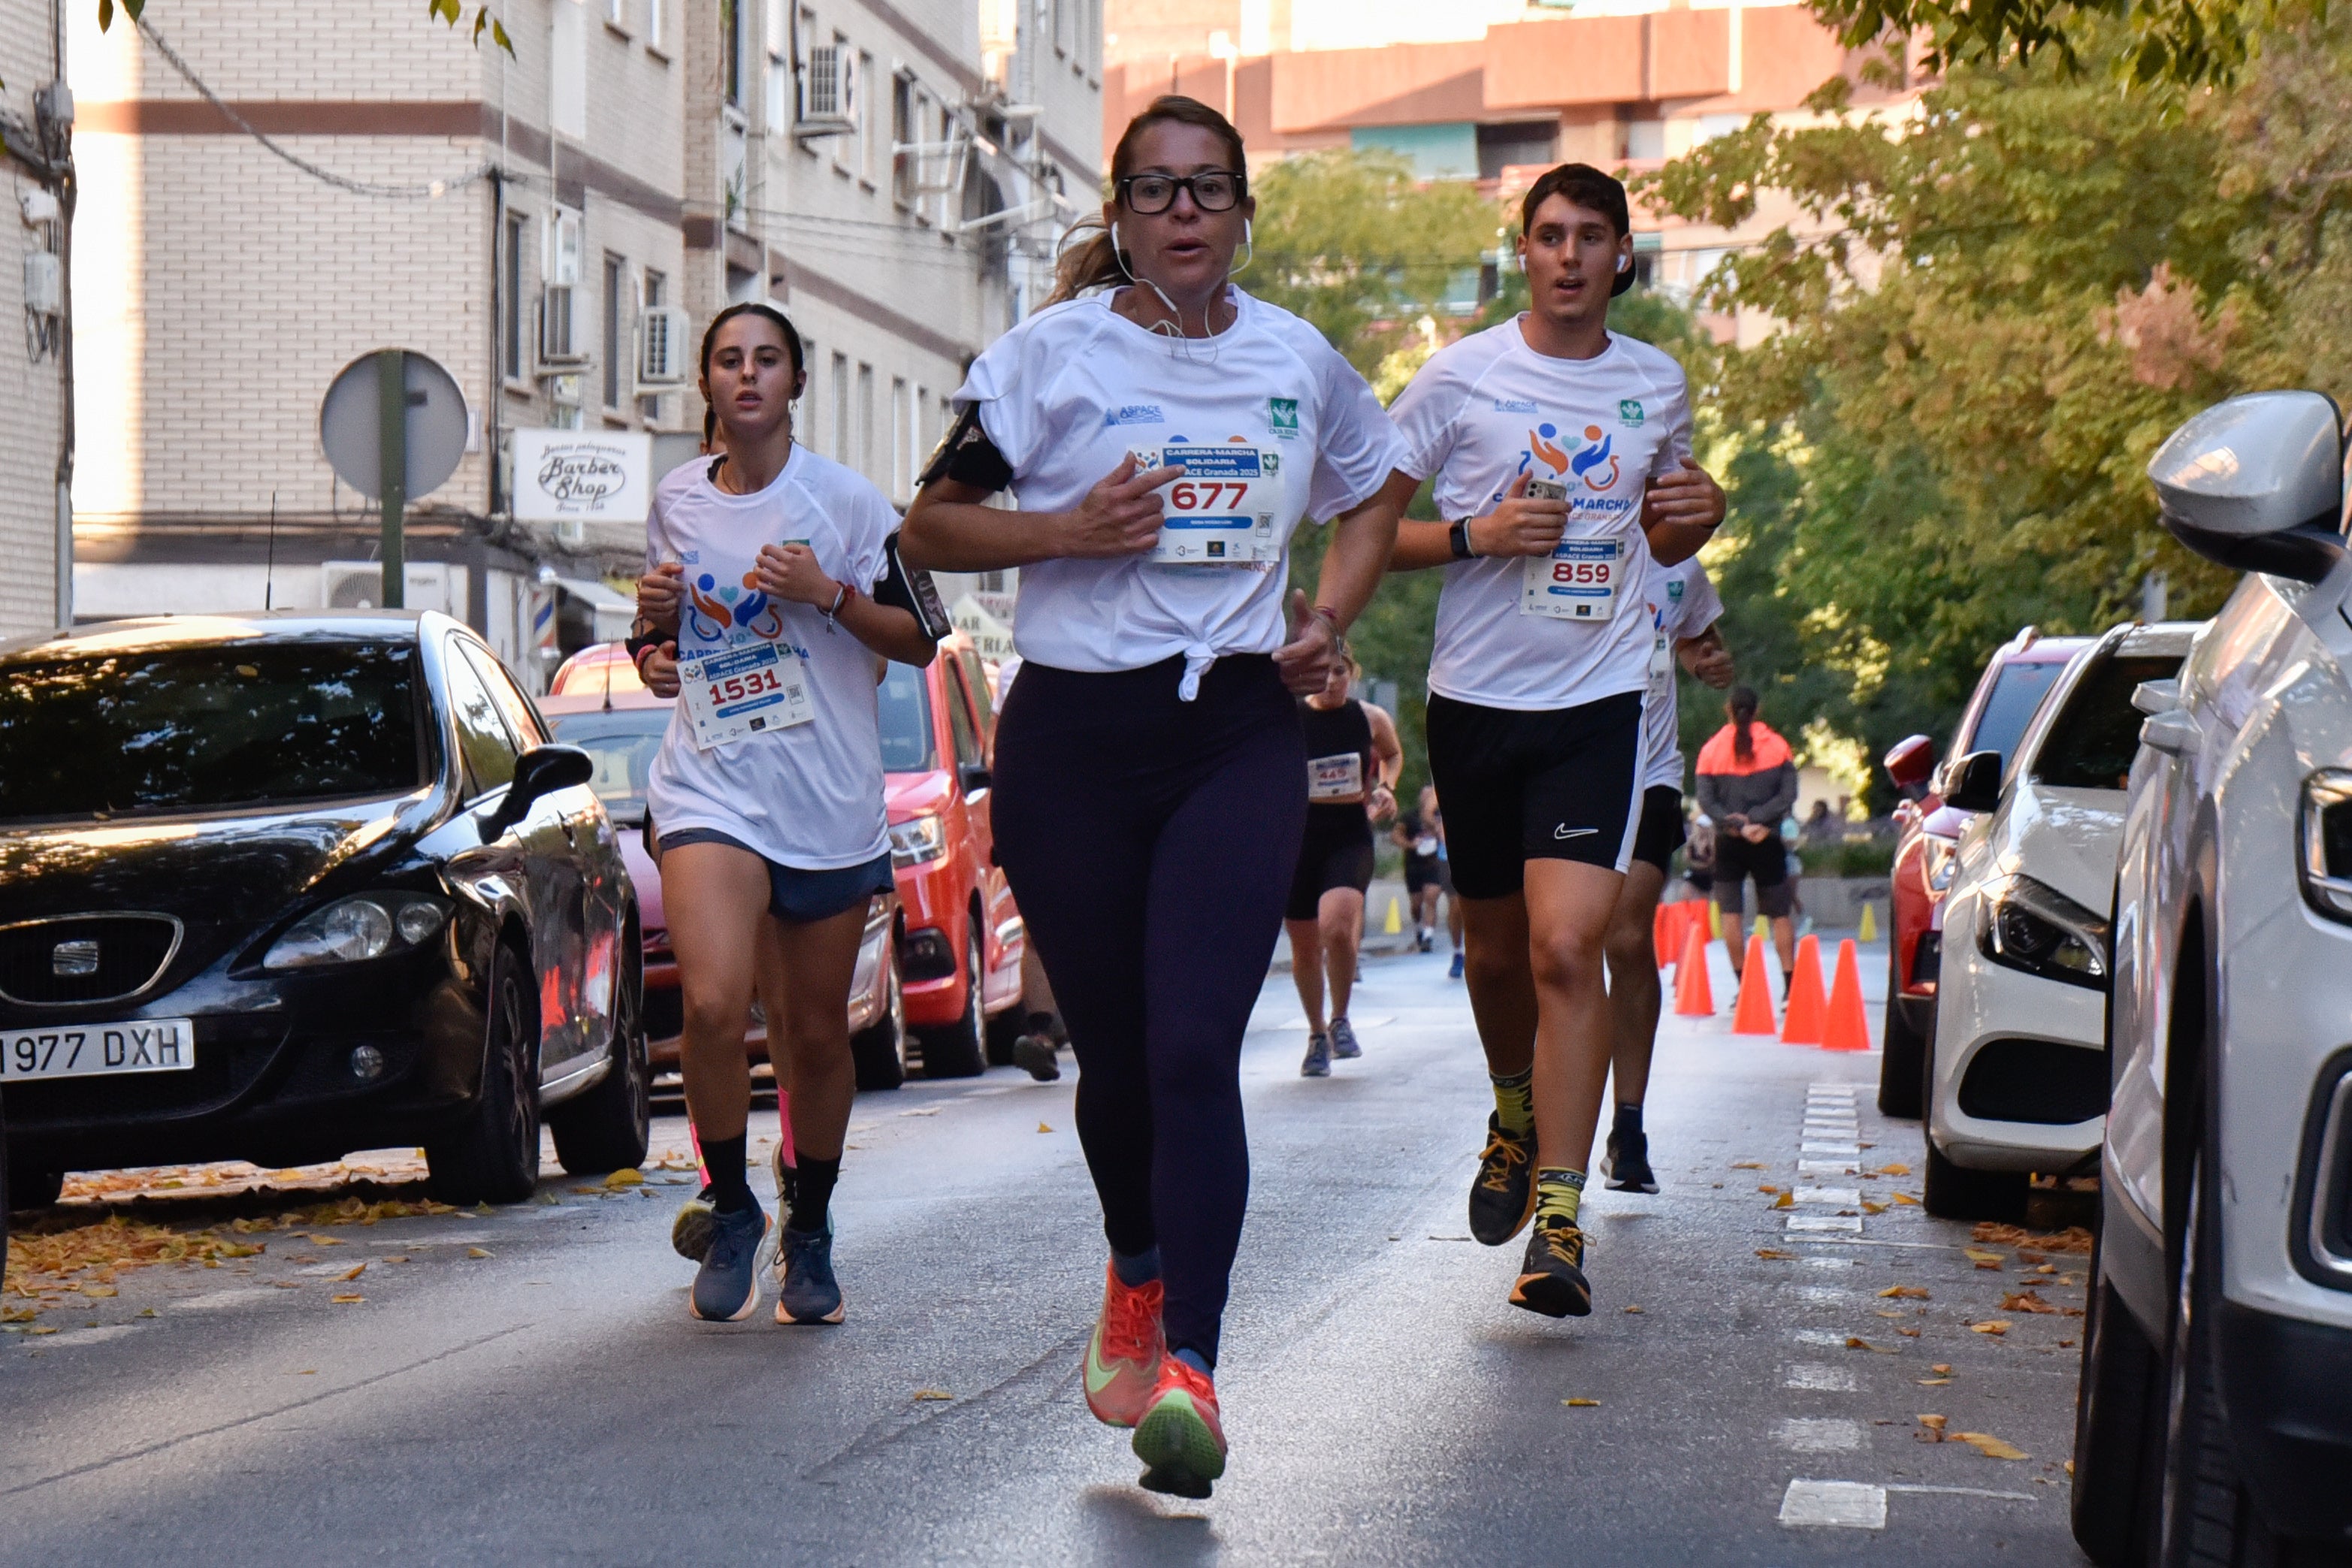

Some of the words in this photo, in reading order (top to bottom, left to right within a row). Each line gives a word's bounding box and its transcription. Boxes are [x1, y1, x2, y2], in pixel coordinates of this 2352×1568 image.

[1120, 406, 1162, 418] ASPACE
[1166, 449, 1256, 457] CARRERA-MARCHA
[538, 457, 619, 485] Barber
[1204, 467, 1238, 476] Granada
[1240, 468, 1259, 476] 2025
[555, 476, 607, 504] Shop
[1171, 482, 1248, 510] 677
[1552, 563, 1610, 583] 859
[709, 669, 733, 681] ASPACE
[733, 663, 760, 674] Granada
[709, 669, 782, 705] 1531
[0, 1032, 86, 1074] 1977
[104, 1027, 180, 1067] DXH
